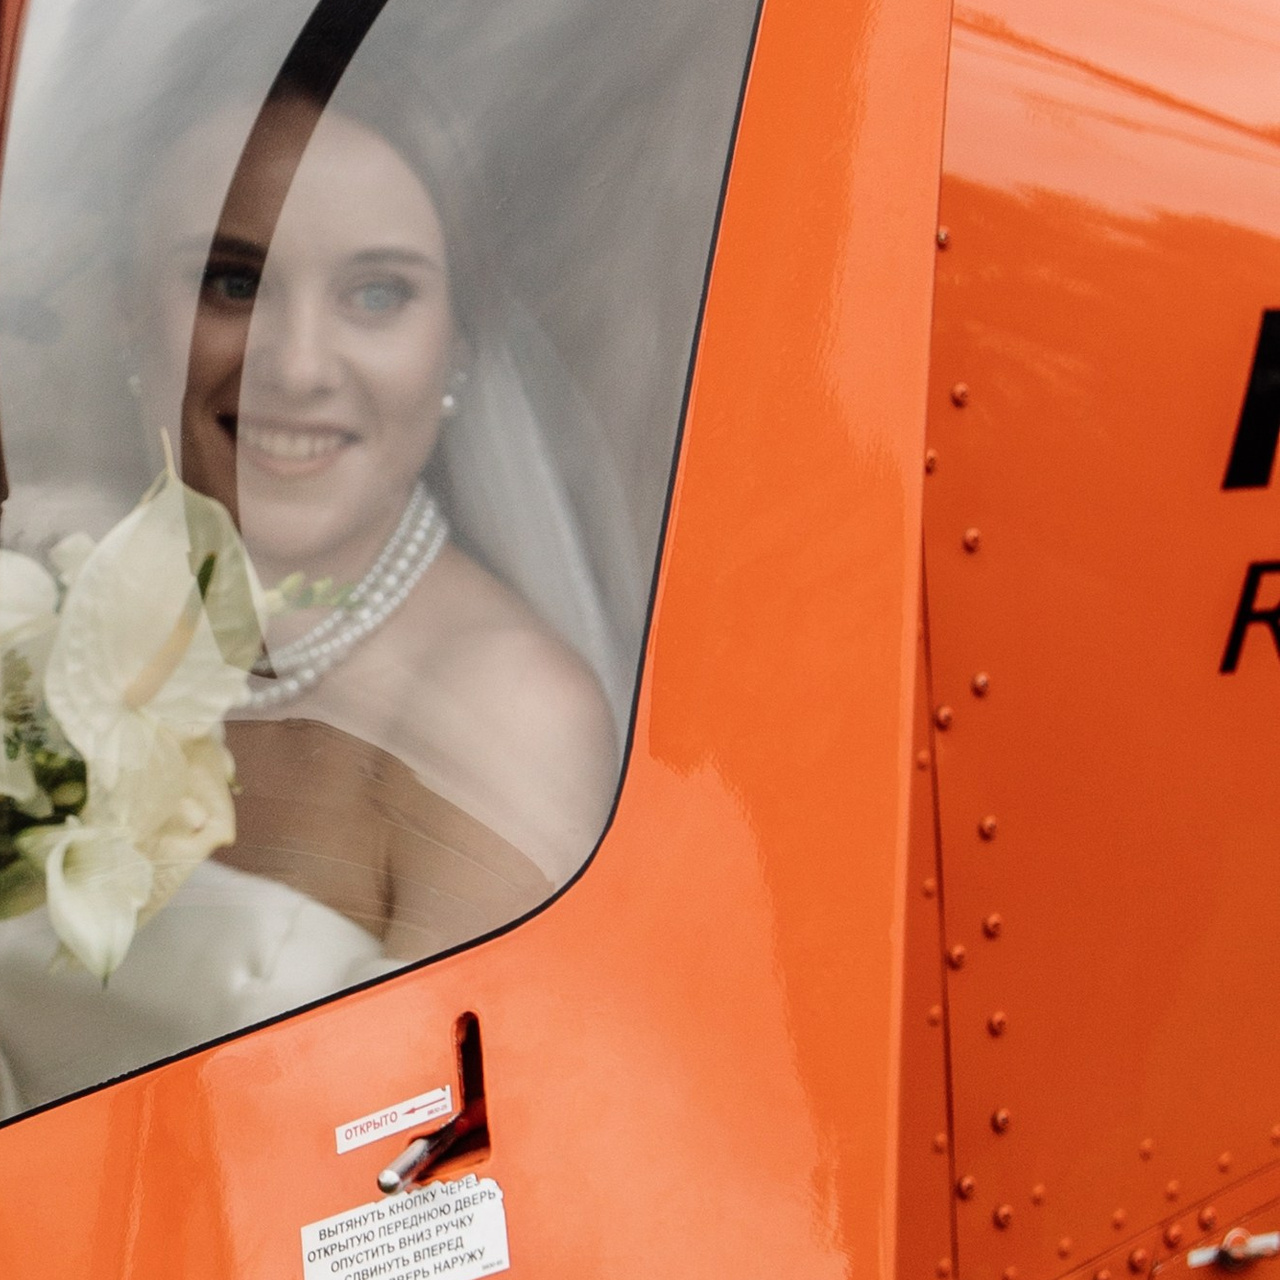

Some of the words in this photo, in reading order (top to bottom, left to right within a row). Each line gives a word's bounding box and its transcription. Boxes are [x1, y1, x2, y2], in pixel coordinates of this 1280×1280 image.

[344, 1110, 398, 1141] ОТКРЫТО
[307, 1229, 375, 1264] ОТКРЫТУЮ
[378, 1203, 451, 1238] ПЕРЕДНЮЮ
[454, 1189, 496, 1215] ДВЕРЬ
[318, 1209, 386, 1242] ВЫТЯНУТЬ
[389, 1189, 437, 1218] КНОПКУ
[330, 1241, 395, 1274] ОПУСТИТЬ
[399, 1228, 432, 1251] ВНИЗ
[435, 1212, 476, 1238] РУЧКУ
[413, 1235, 464, 1262] ВПЕРЕД
[433, 1246, 487, 1278] НАРУЖУ
